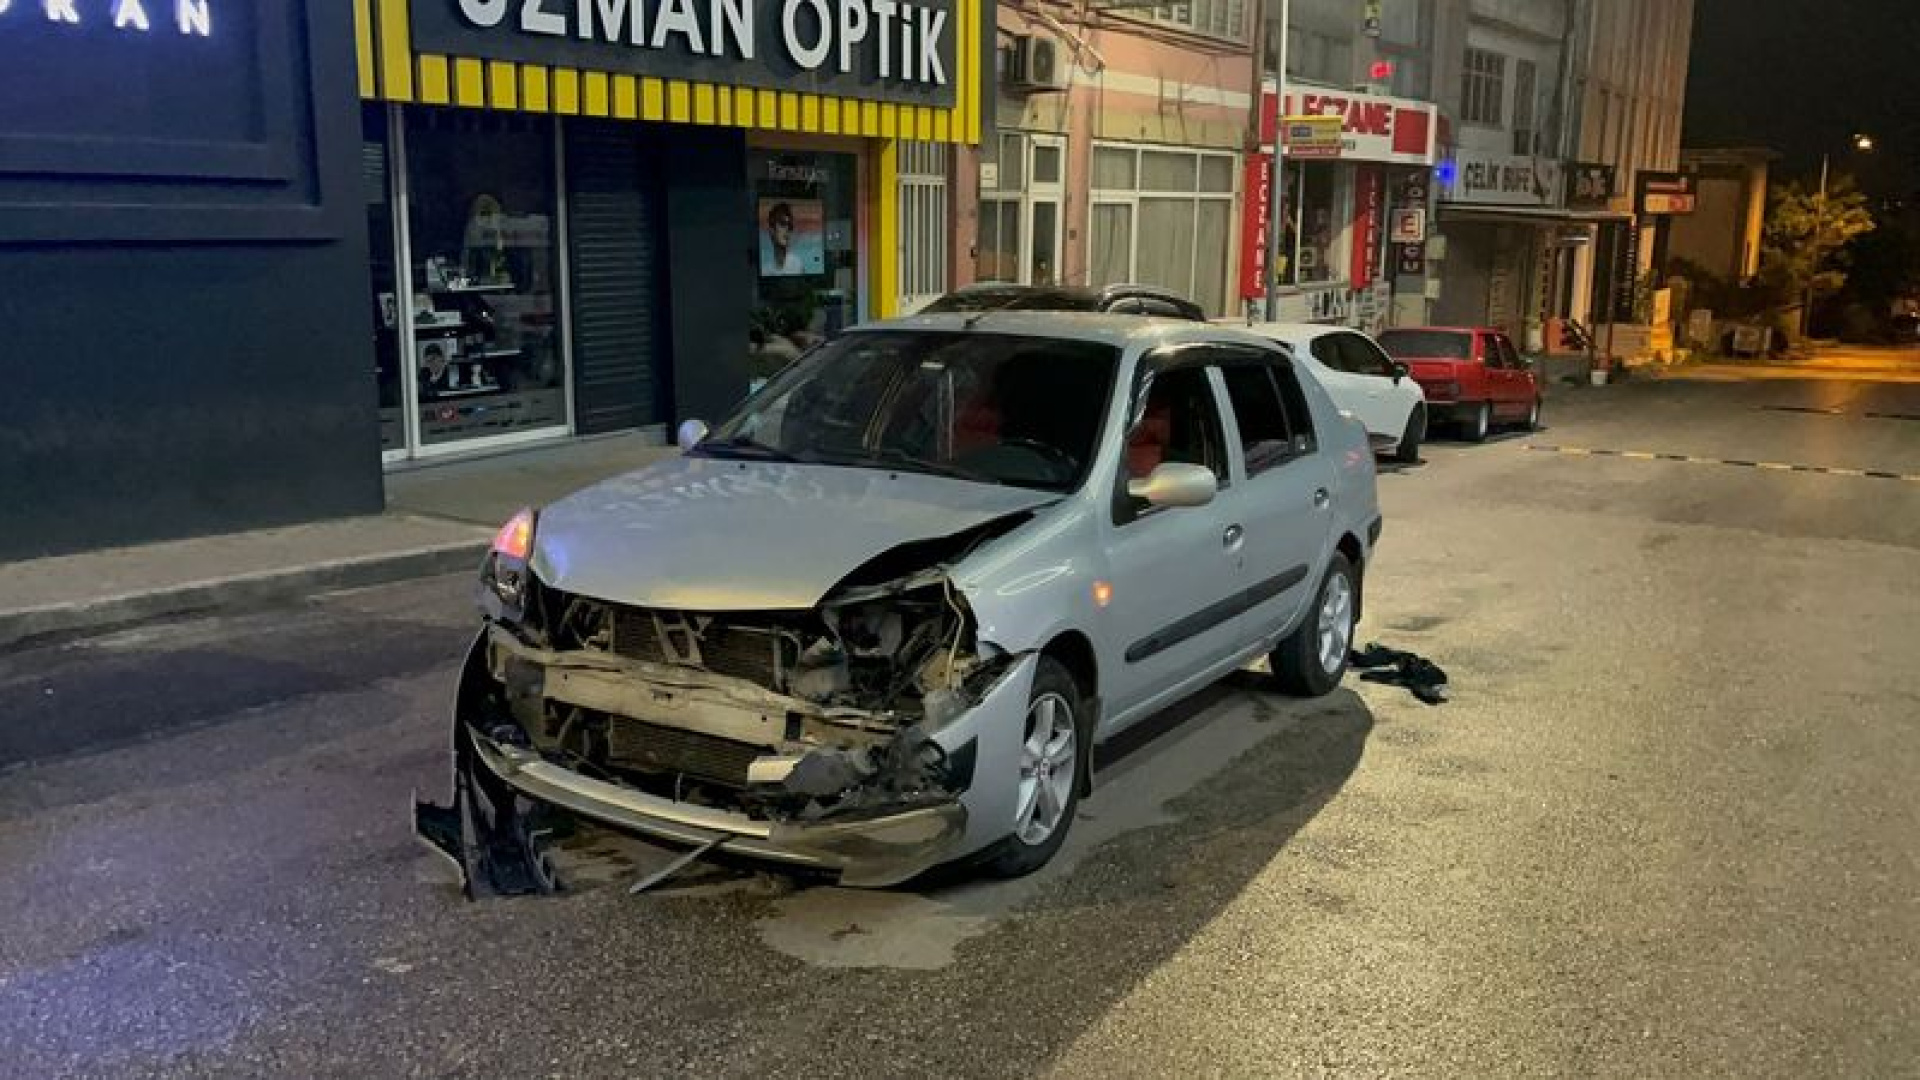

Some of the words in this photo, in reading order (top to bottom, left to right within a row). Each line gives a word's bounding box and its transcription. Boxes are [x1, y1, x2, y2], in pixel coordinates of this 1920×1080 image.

[0, 0, 210, 37] RAN
[1302, 93, 1393, 137] ECZANE
[1253, 161, 1269, 290] ECZANE
